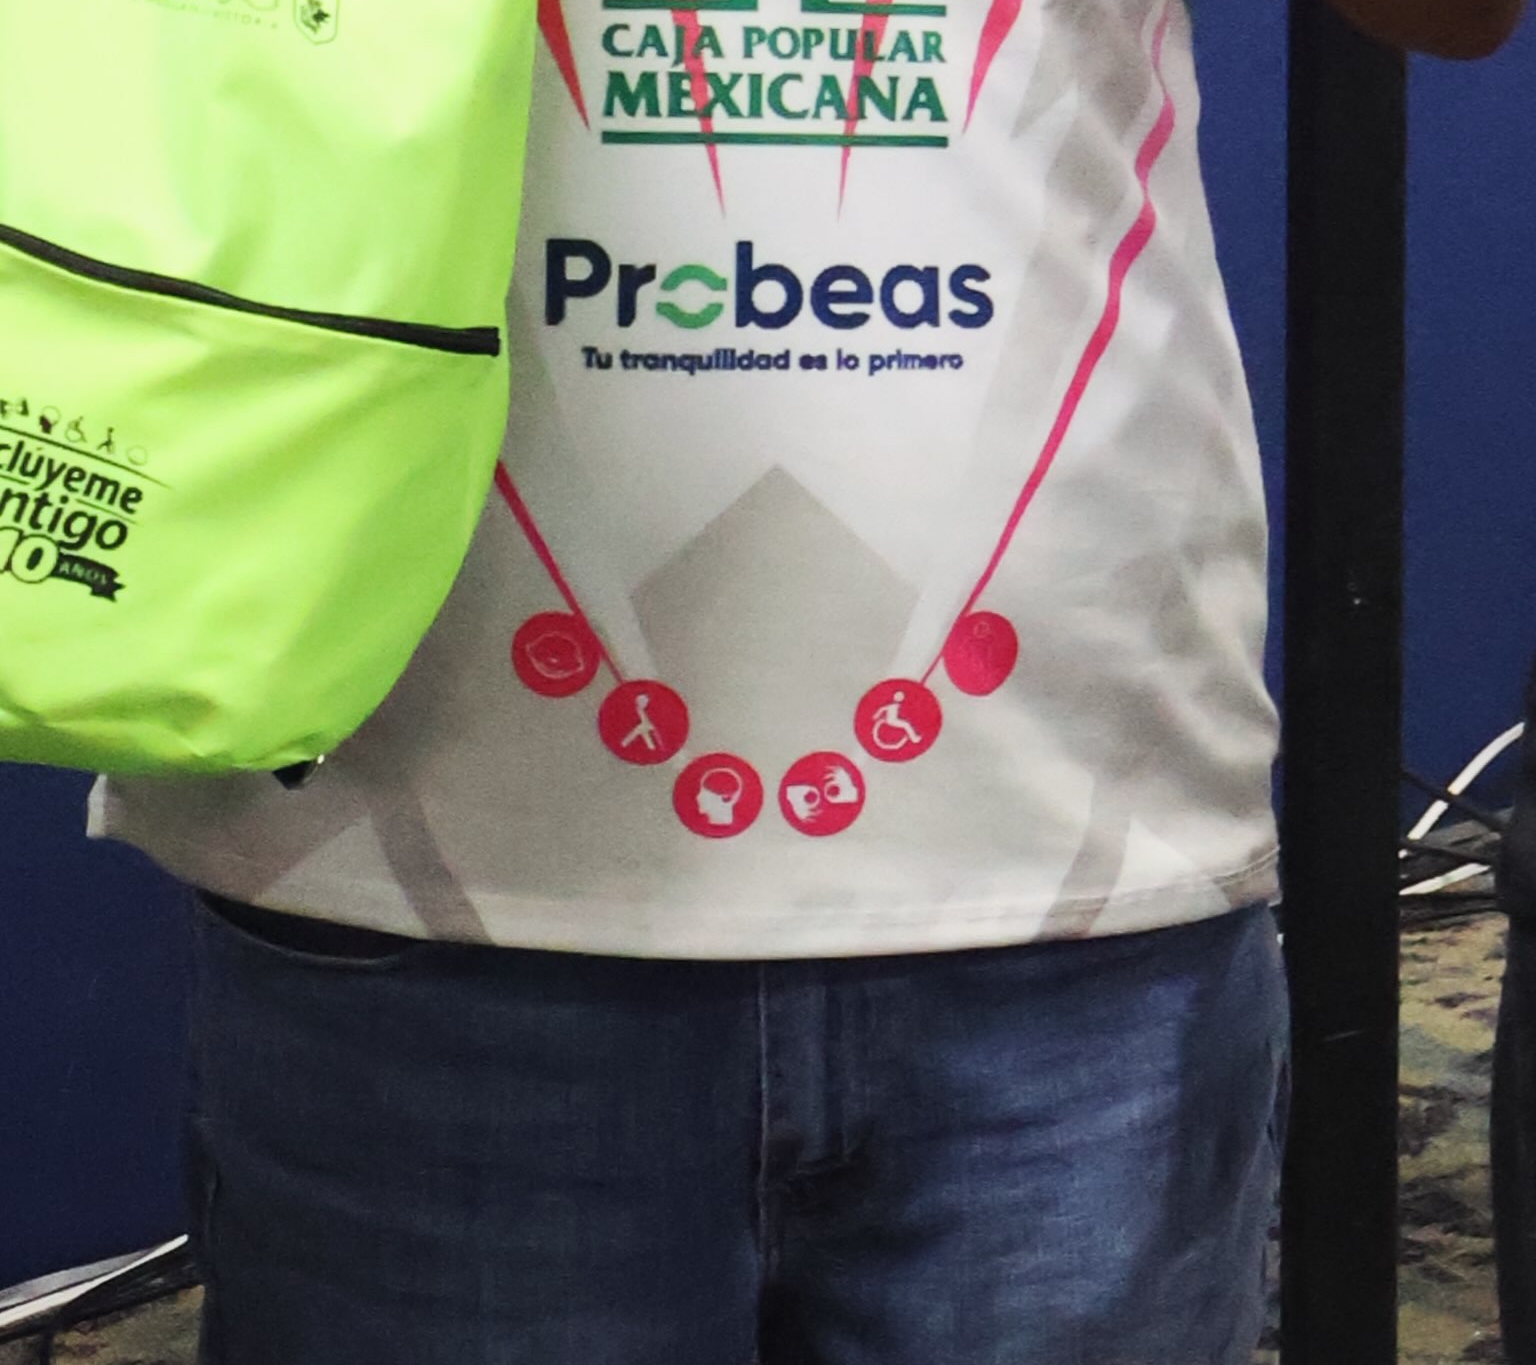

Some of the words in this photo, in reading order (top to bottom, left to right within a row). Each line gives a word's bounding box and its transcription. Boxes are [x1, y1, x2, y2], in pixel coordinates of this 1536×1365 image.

[602, 24, 725, 66] CAJA
[743, 26, 947, 63] POPULAR
[602, 71, 948, 123] MEXICANA
[545, 238, 994, 330] Probeas
[581, 347, 613, 370] Tu
[620, 349, 790, 376] tranquilidad
[798, 353, 828, 370] es
[836, 349, 860, 370] lo
[868, 349, 964, 376] primero
